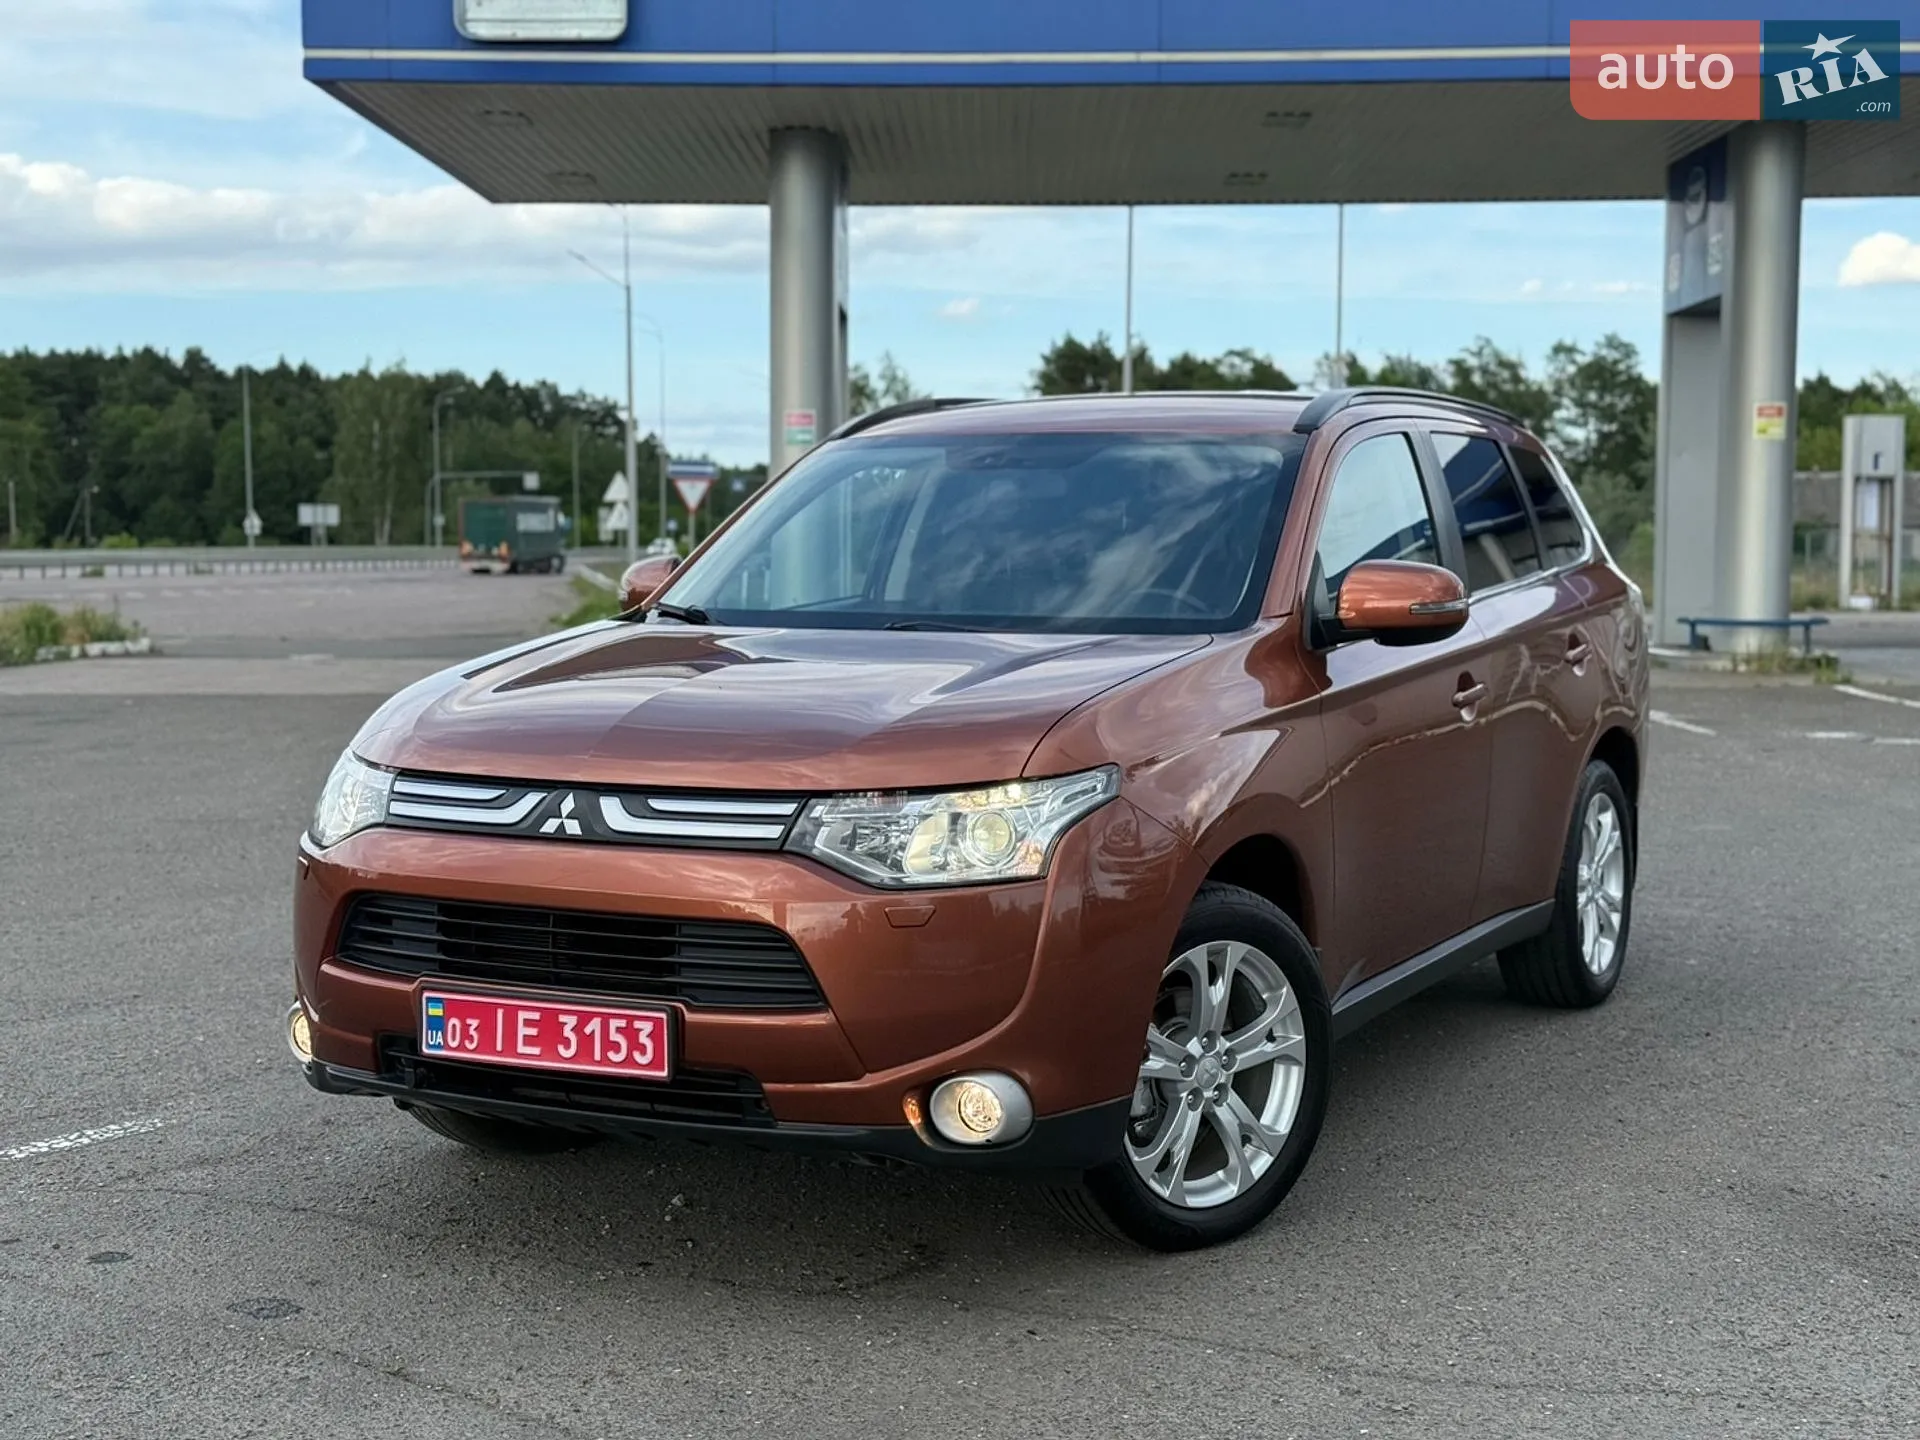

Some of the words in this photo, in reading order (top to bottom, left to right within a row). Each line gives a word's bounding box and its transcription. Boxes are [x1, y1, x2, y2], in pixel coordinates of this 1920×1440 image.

[427, 1029, 444, 1046] UA
[447, 1017, 480, 1050] 03
[495, 1008, 541, 1055] IE
[557, 1014, 654, 1065] 3153
